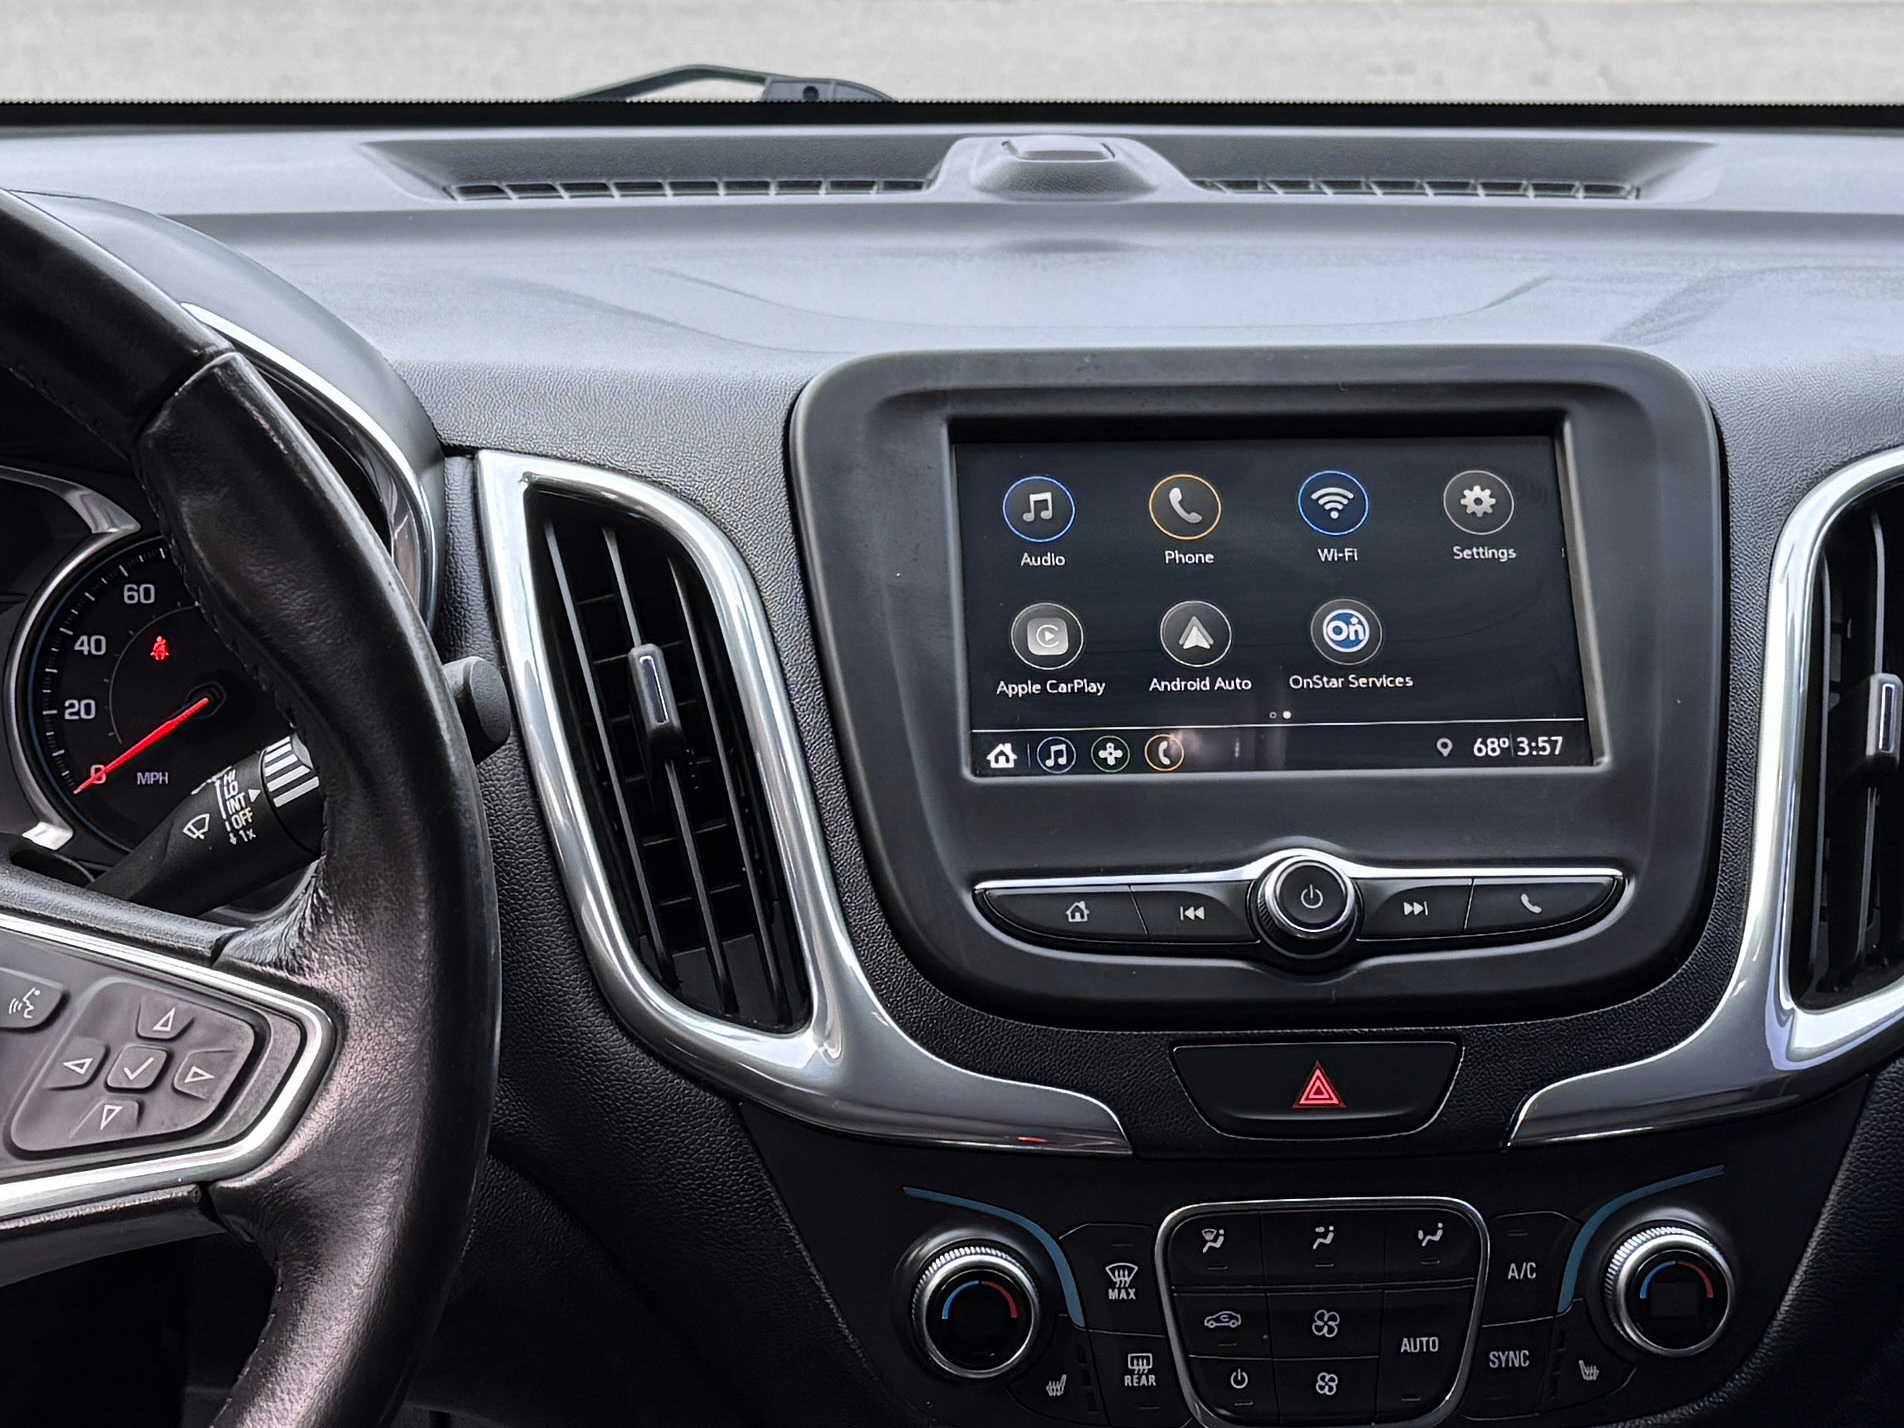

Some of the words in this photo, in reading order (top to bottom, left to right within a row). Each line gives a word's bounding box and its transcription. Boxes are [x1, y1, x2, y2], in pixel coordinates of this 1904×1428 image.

[1020, 551, 1066, 567] Audio
[1164, 548, 1216, 566] Phone
[1317, 546, 1359, 562] Wi-Fi
[1452, 545, 1517, 564] Settings
[122, 583, 156, 605] 60
[73, 634, 107, 656] 40
[996, 679, 1042, 697] Apple
[1046, 677, 1107, 696] CarPlay
[1149, 676, 1212, 692] Android
[1215, 676, 1253, 691] Auto
[1289, 673, 1344, 690] OnStar
[1347, 673, 1415, 690] Services
[63, 698, 97, 721] 20
[1516, 735, 1565, 758] 3:57
[136, 771, 169, 786] MPH
[223, 781, 240, 798] LO
[226, 791, 247, 814] INT
[231, 807, 254, 829] OFF
[1507, 1262, 1538, 1281] A/C
[1107, 1287, 1137, 1301] MAX
[1400, 1336, 1440, 1353] AUTO
[1488, 1350, 1530, 1369] SYNC
[1124, 1373, 1157, 1388] REAR
